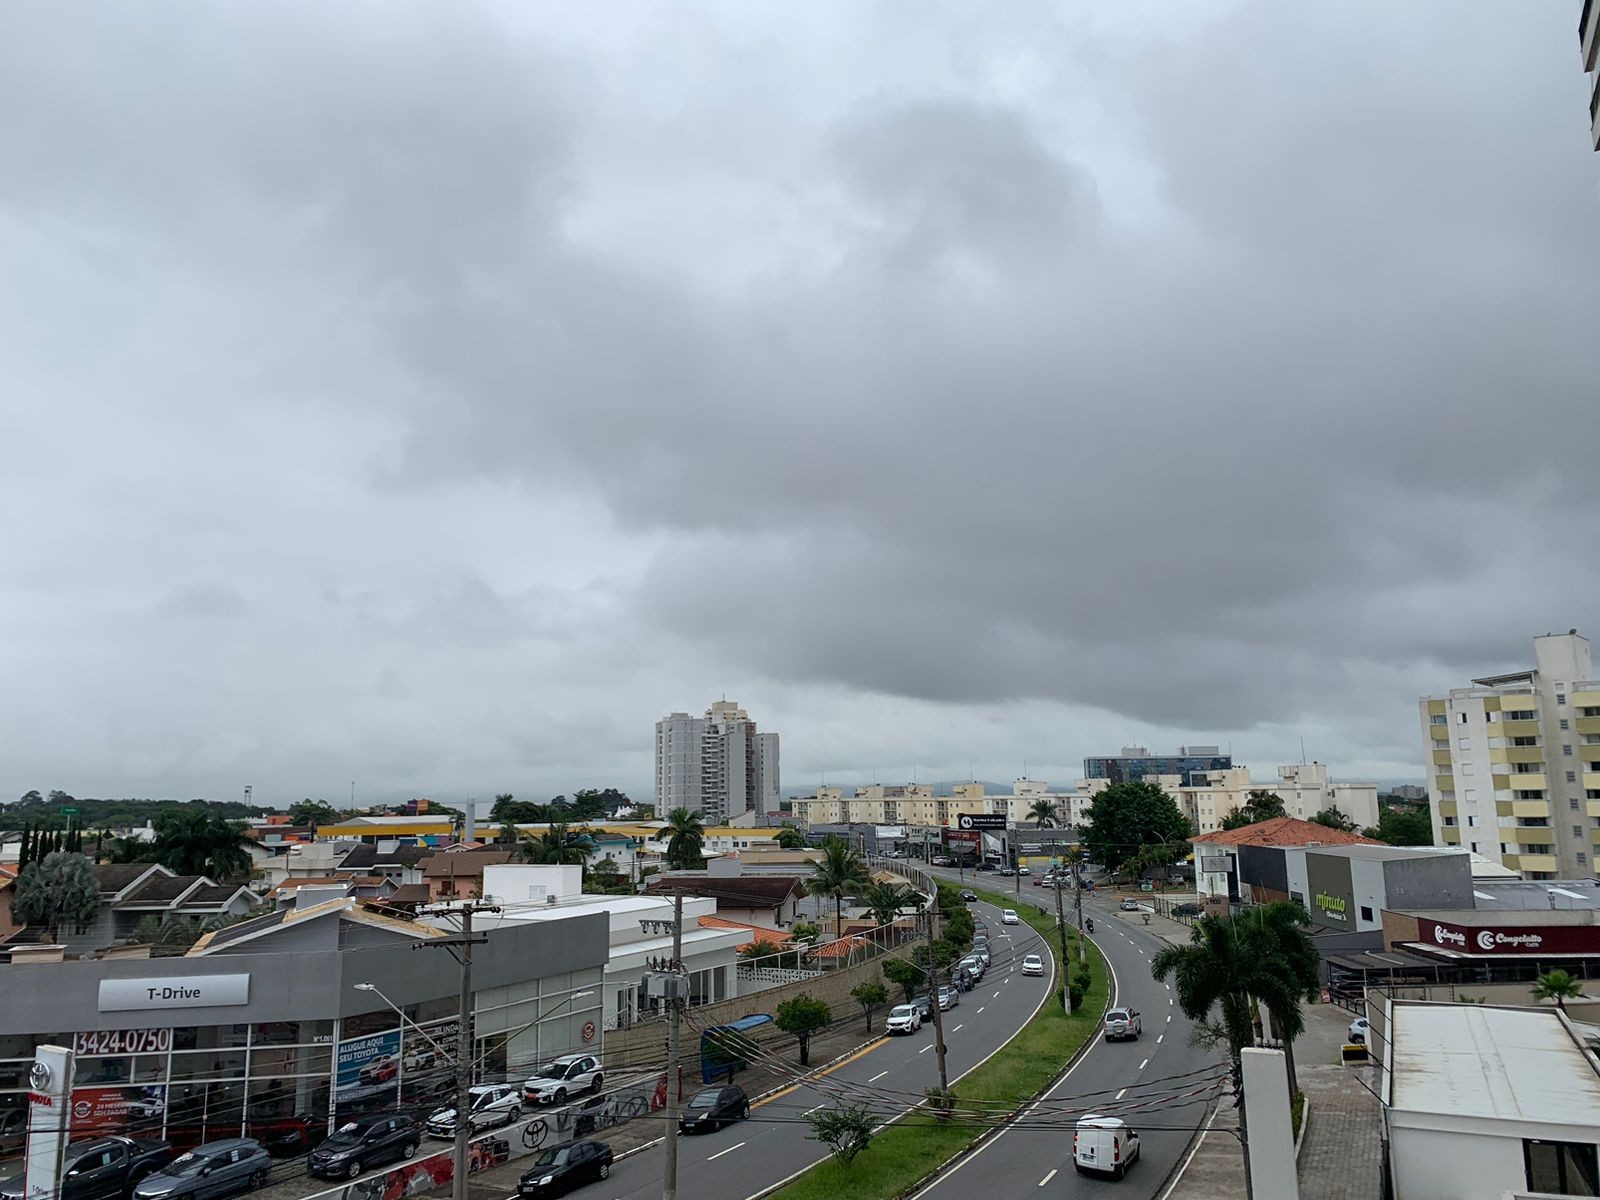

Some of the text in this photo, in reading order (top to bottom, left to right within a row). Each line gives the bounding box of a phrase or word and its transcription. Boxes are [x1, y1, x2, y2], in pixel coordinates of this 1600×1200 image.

[147, 986, 201, 1000] T-Drive
[340, 1036, 384, 1053] ALUGUE AQUI
[339, 1047, 379, 1063] SEU TOYOTA
